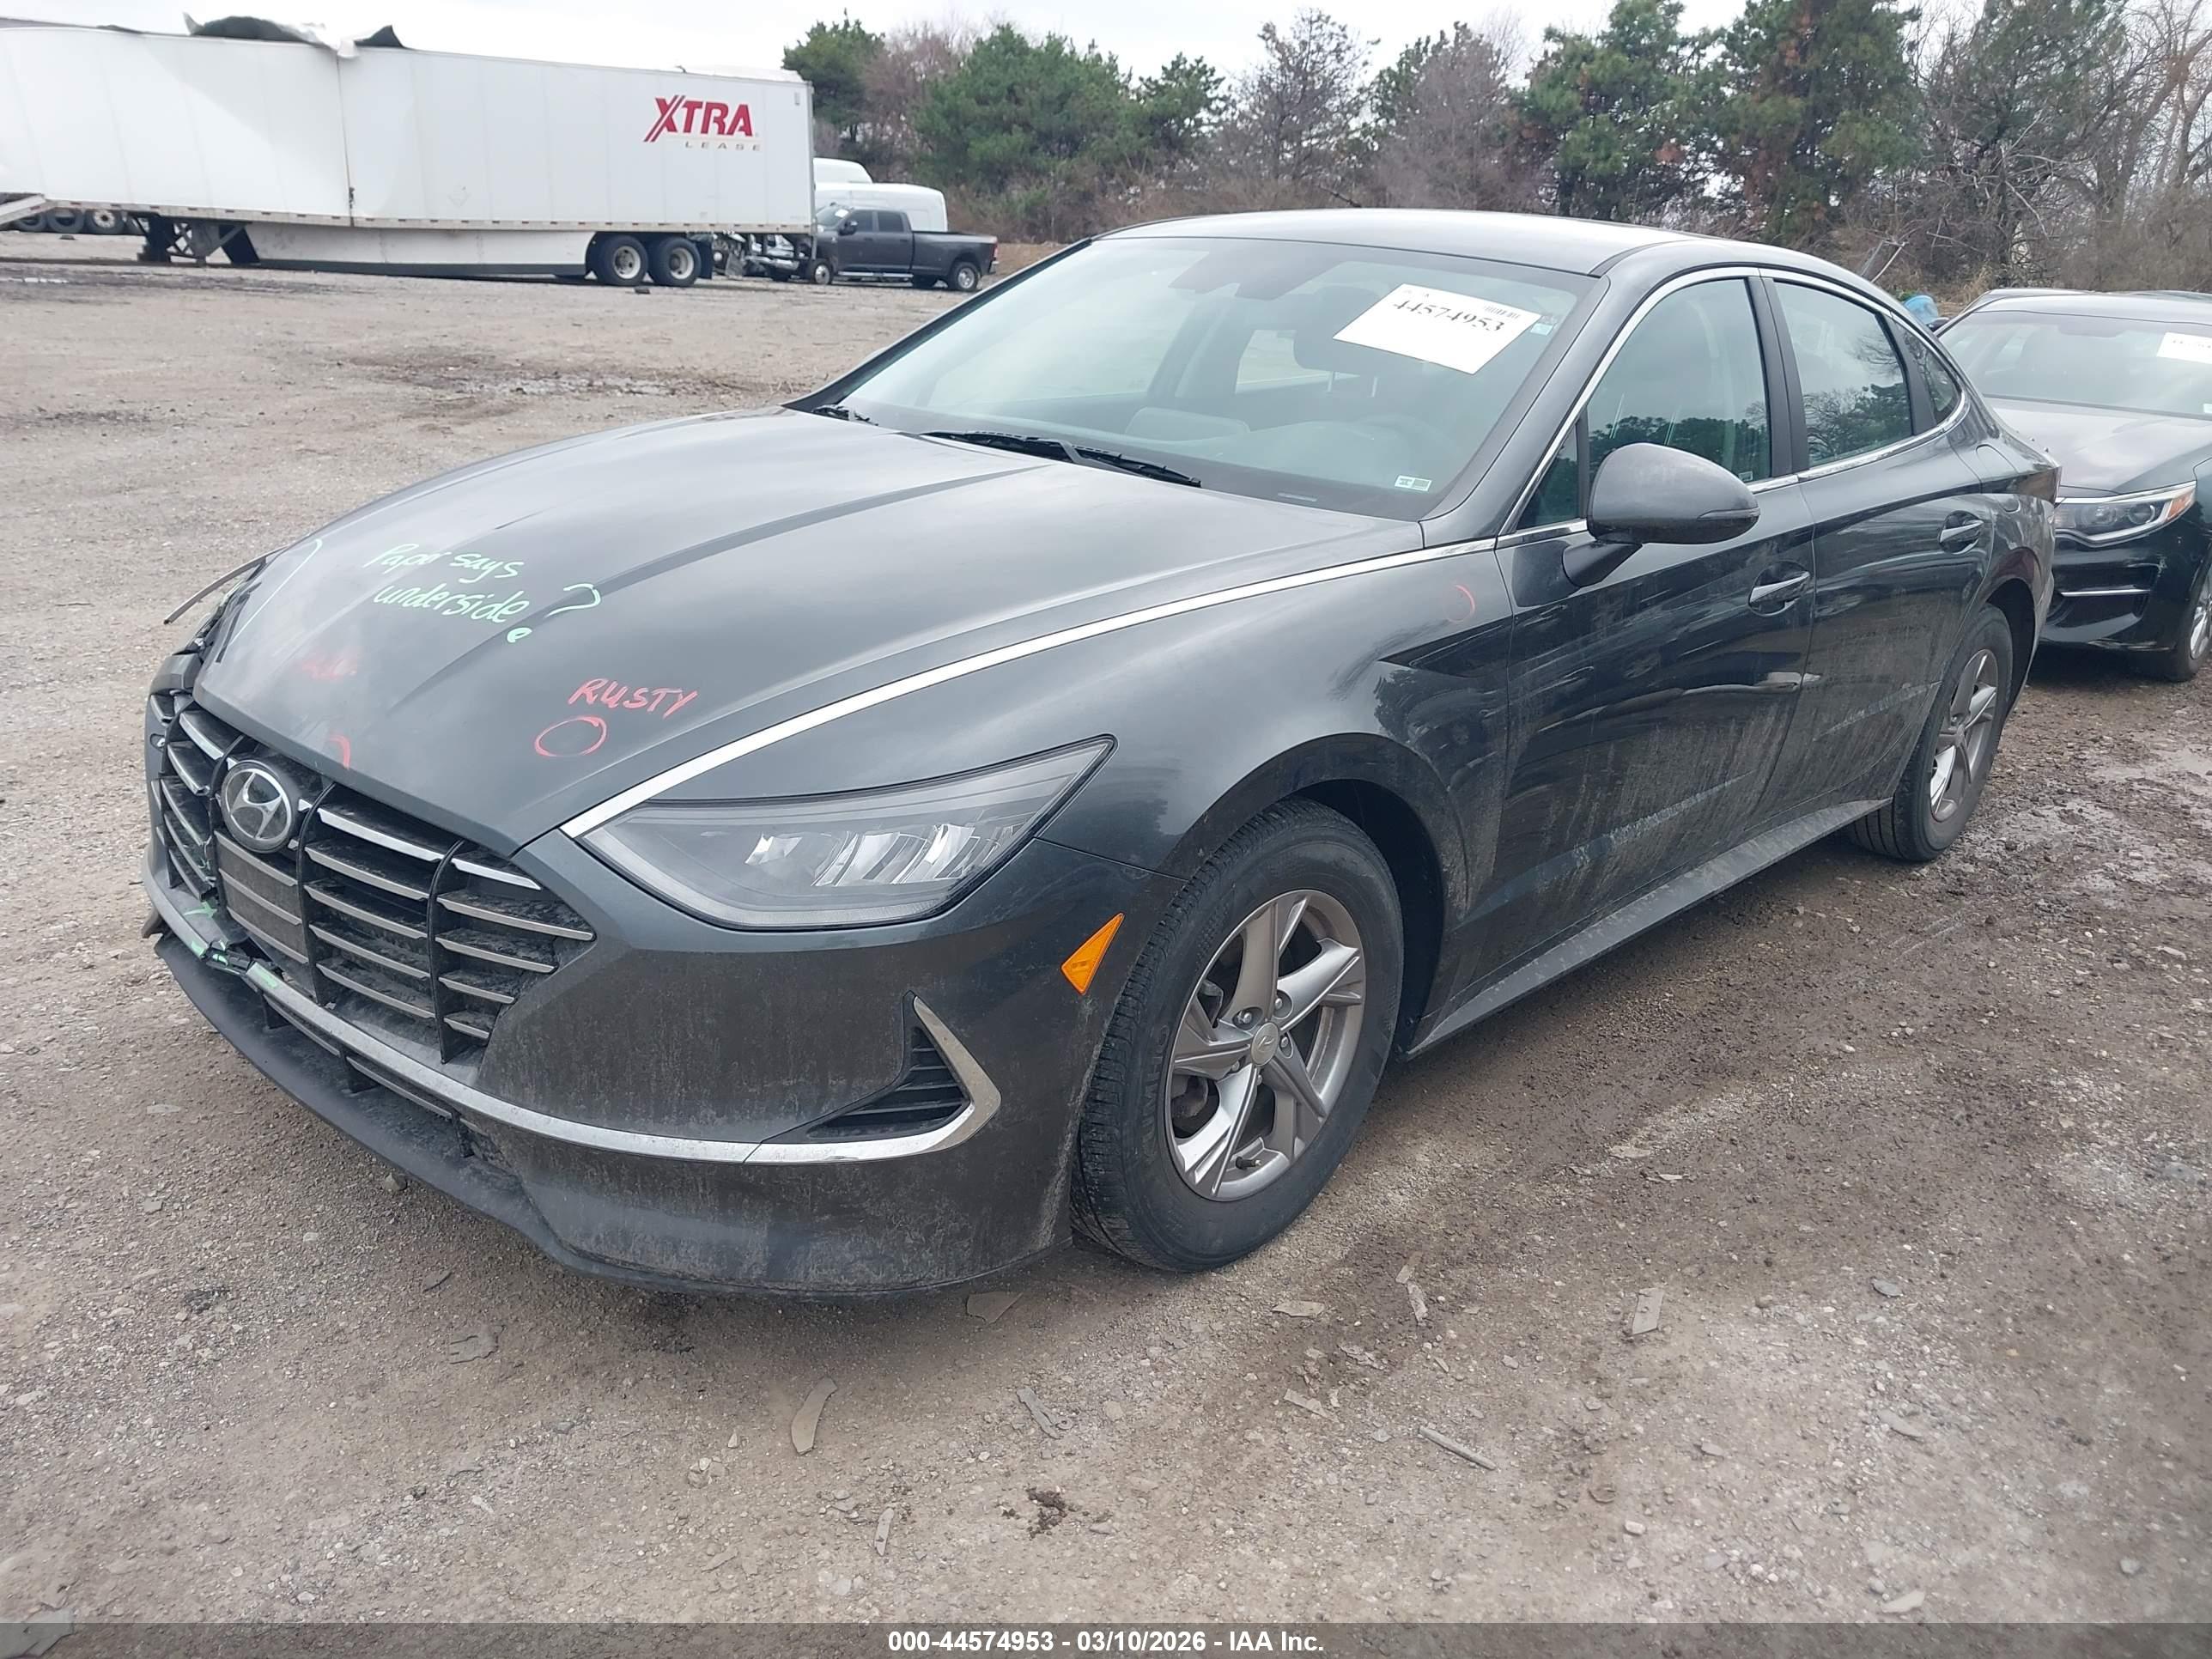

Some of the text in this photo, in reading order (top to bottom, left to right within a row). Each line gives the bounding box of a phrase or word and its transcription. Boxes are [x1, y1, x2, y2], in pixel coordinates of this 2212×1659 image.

[643, 94, 752, 143] XTRA
[685, 141, 761, 151] LEASE
[1392, 299, 1505, 331] 44574953
[449, 553, 526, 584] says
[568, 678, 698, 720] RUSTY
